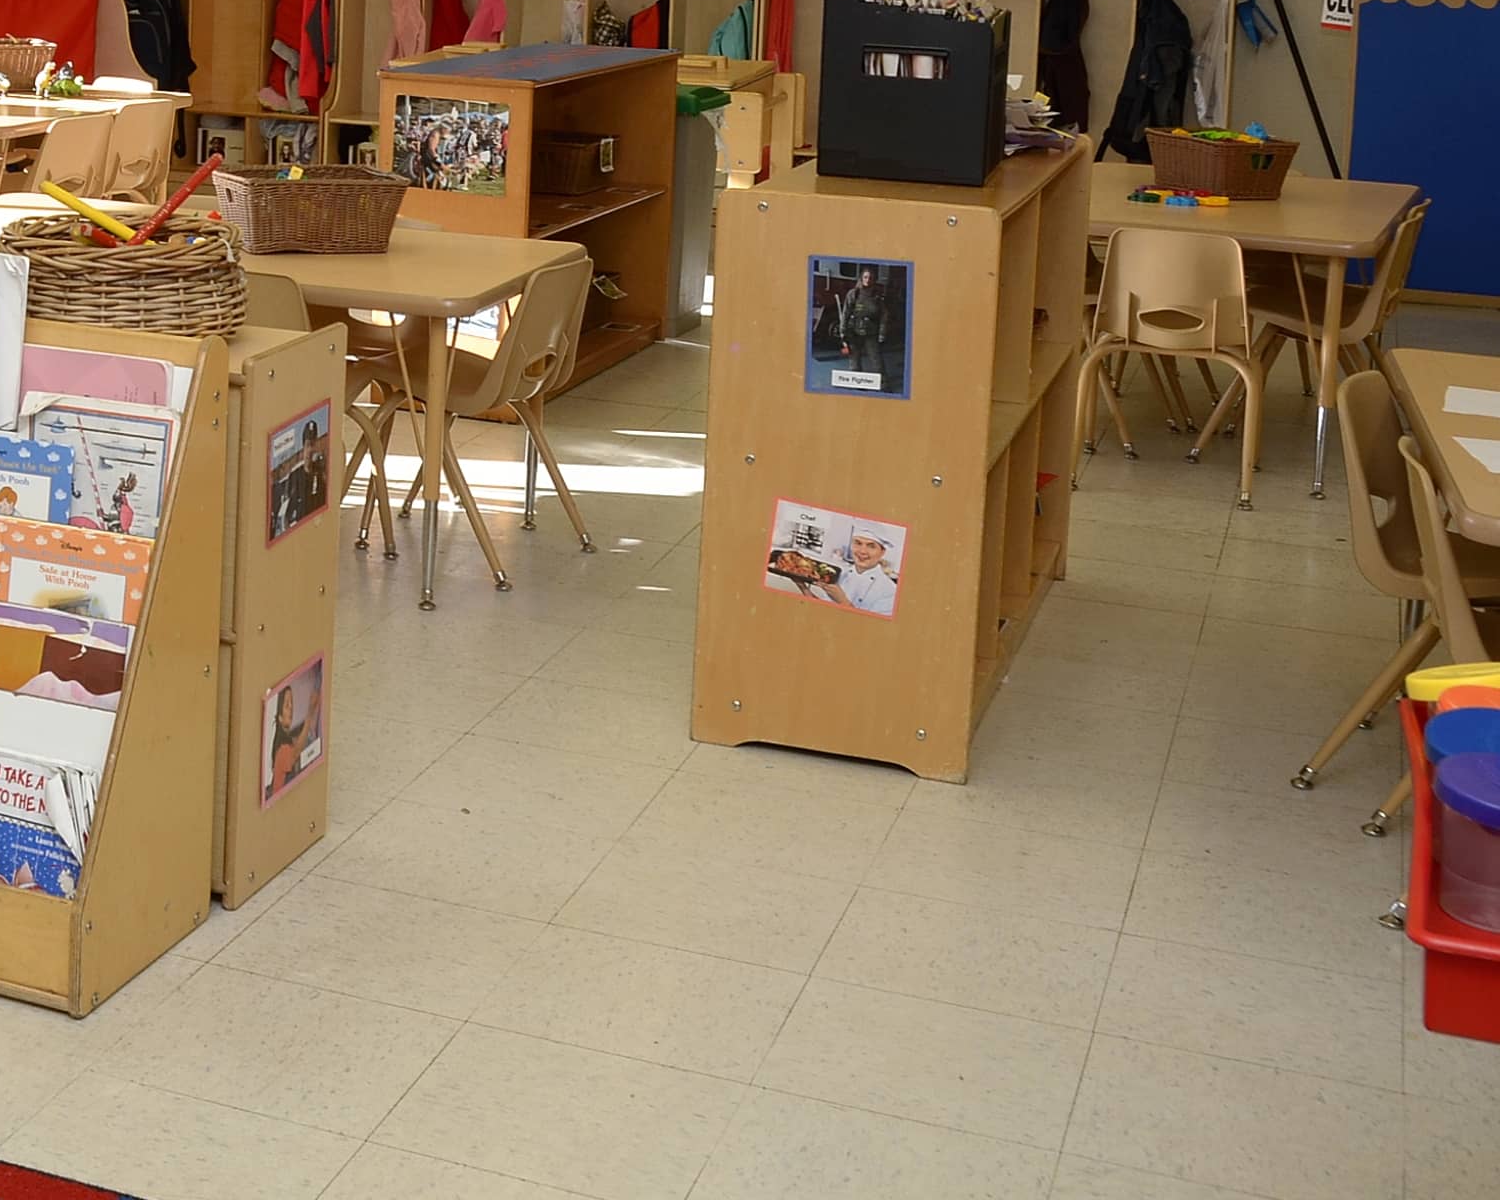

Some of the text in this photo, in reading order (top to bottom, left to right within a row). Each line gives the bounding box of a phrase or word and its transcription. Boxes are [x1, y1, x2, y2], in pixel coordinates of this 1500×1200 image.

[852, 376, 874, 384] Fighter
[8, 476, 30, 487] Pooh
[800, 513, 816, 521] Chef
[38, 564, 97, 582] Safe at Home
[44, 574, 90, 590] With Pooh
[4, 767, 34, 788] TAKE
[35, 775, 45, 790] A
[12, 792, 35, 812] THE
